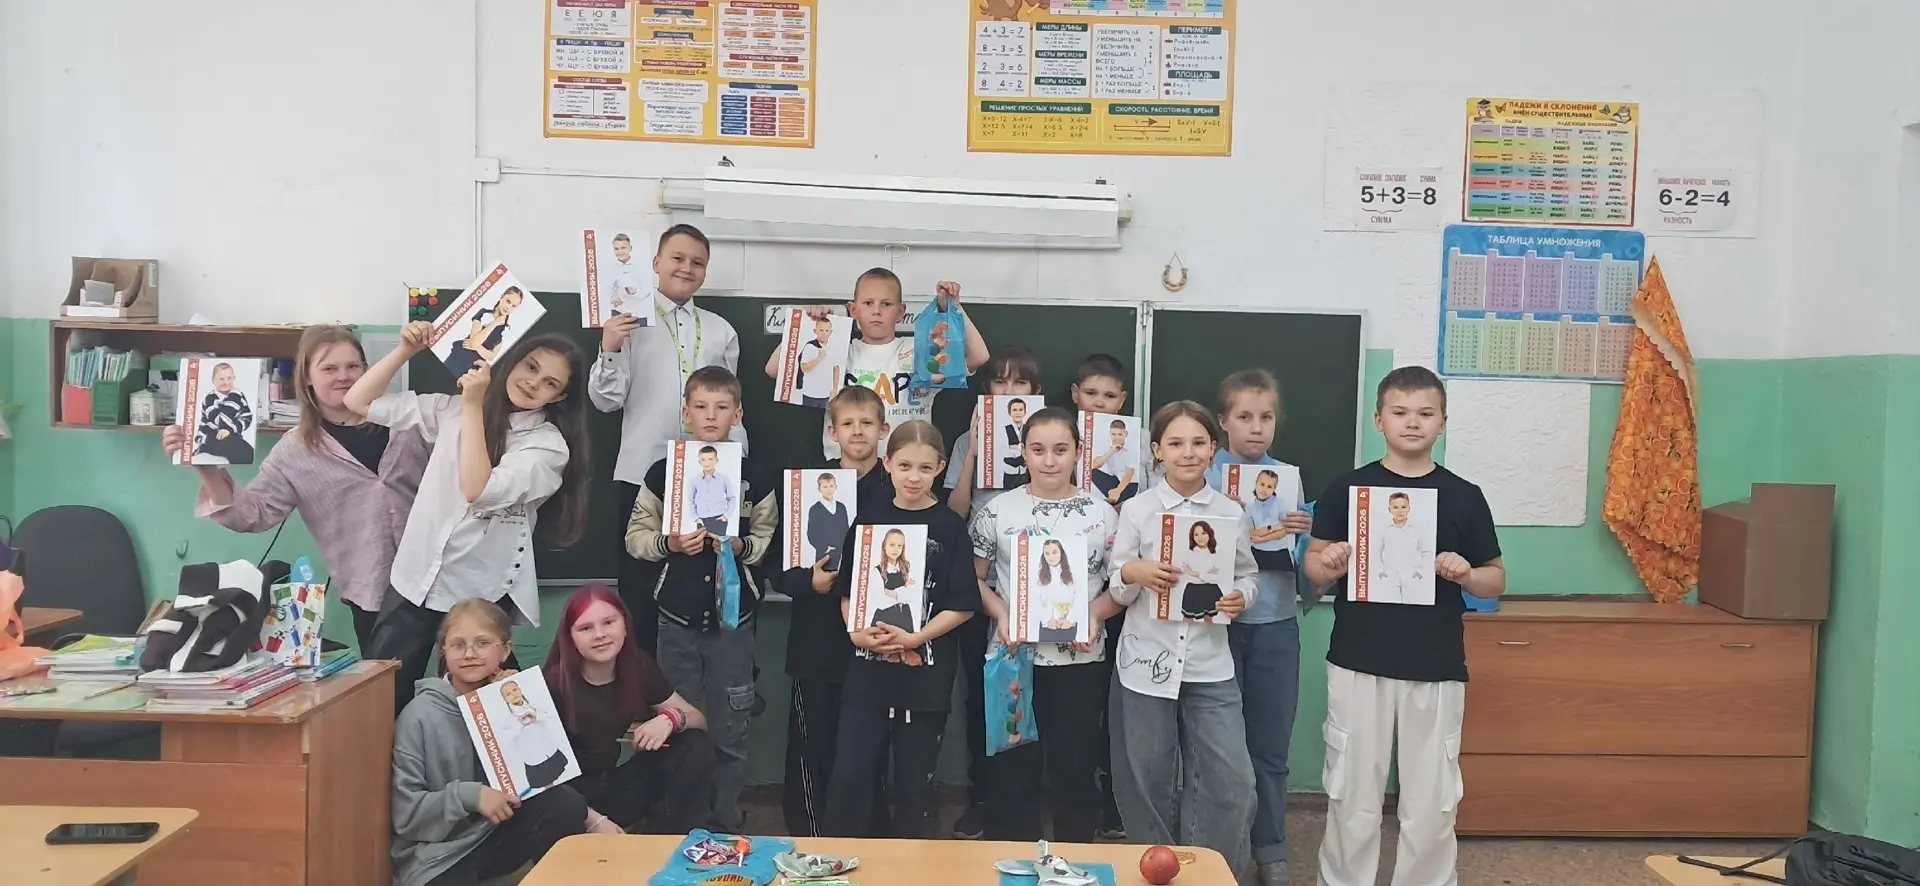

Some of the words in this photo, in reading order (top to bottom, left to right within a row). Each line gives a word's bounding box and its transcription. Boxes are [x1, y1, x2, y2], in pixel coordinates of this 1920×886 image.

[1001, 26, 1006, 34] 3
[1018, 45, 1023, 53] 5
[982, 62, 987, 70] 2
[1017, 80, 1022, 88] 2
[1361, 186, 1436, 205] 5+3=8
[1659, 188, 1730, 206] 6-2=4
[1488, 235, 1534, 246] ТАБЛИЦА
[1536, 236, 1601, 248] УМНОЖЕНИЯ
[589, 271, 598, 324] ВЫПУСКНИК
[782, 349, 795, 400] ВЫПУСКНИК
[672, 480, 681, 532] ВЫПУСКНИК
[1359, 536, 1367, 598] ВЫПУСКНИК
[857, 569, 868, 628] ВЫПУСКНИК
[488, 741, 515, 796] ЫПУСКНИК
